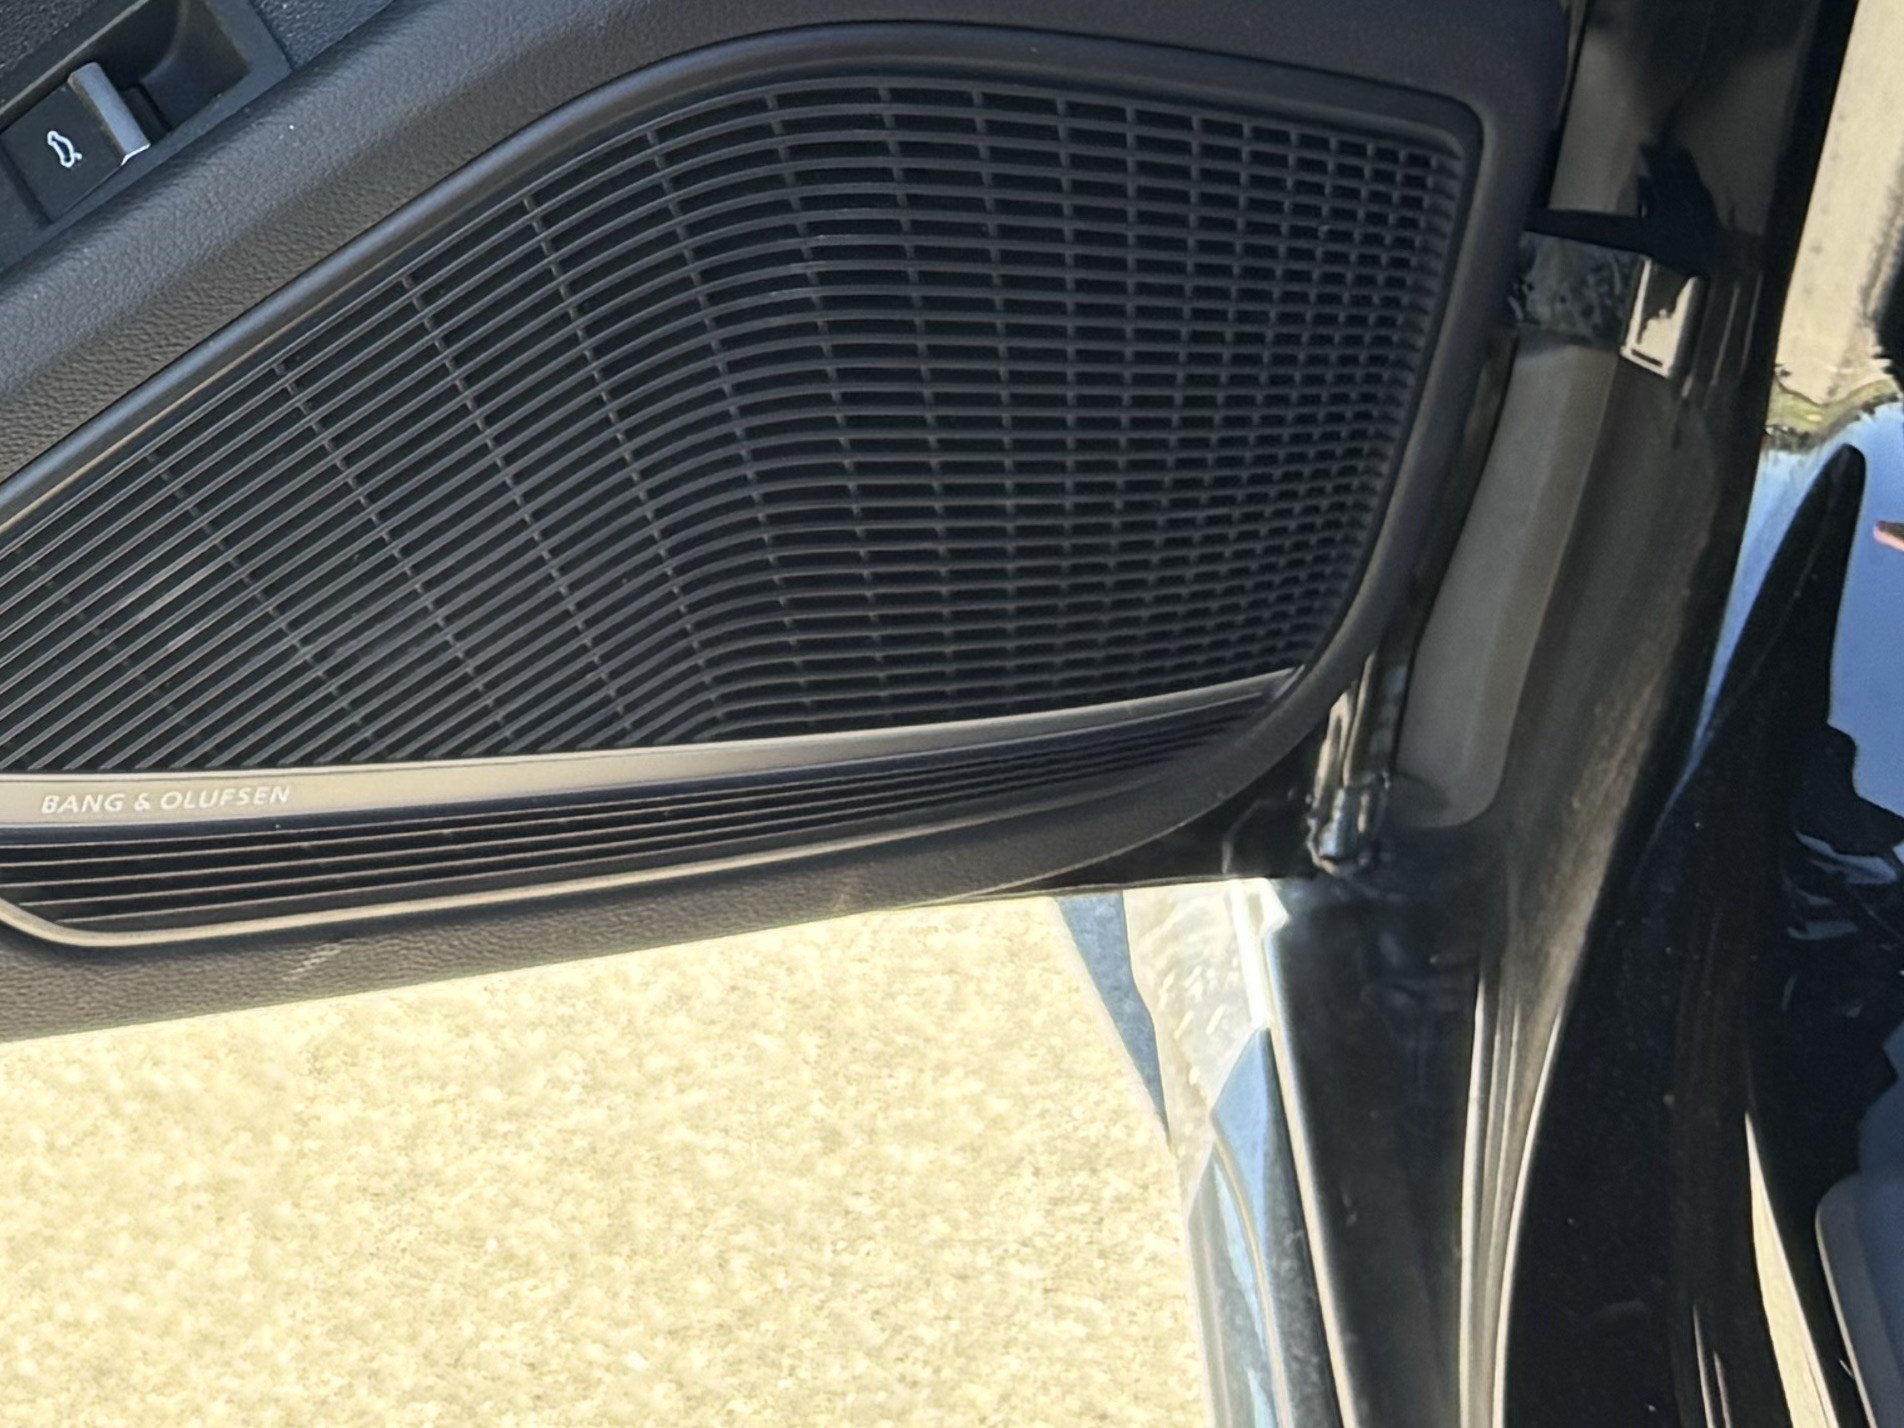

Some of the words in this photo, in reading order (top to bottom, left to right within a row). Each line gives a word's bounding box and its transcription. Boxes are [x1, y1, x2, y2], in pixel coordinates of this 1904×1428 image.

[41, 793, 123, 814] BANG
[134, 792, 152, 812] &
[160, 785, 291, 810] OLUFSEN
